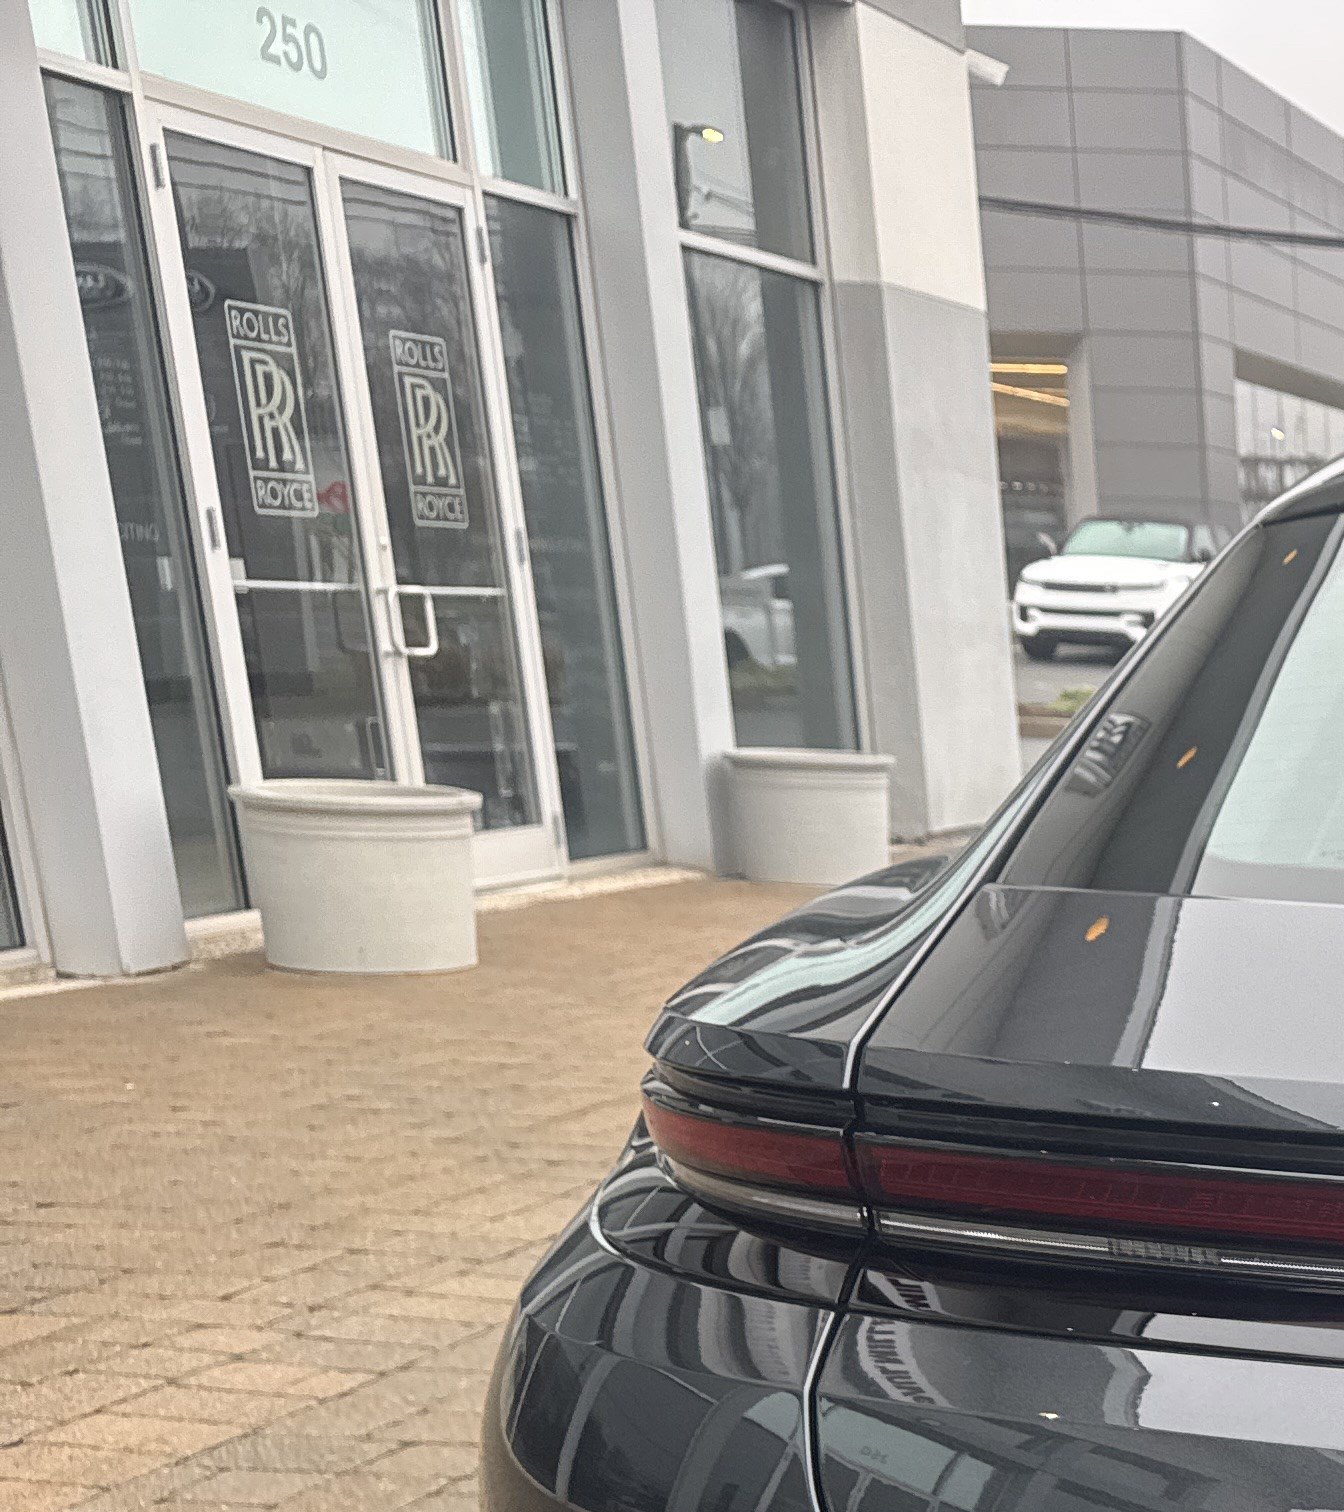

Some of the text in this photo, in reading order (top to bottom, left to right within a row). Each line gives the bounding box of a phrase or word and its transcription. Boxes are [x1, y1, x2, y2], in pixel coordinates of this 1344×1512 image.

[256, 6, 327, 80] 250
[231, 310, 289, 343] ROLLS
[395, 340, 444, 370] ROLLS
[256, 481, 313, 511] ROYCE
[416, 495, 463, 521] ROYCE
